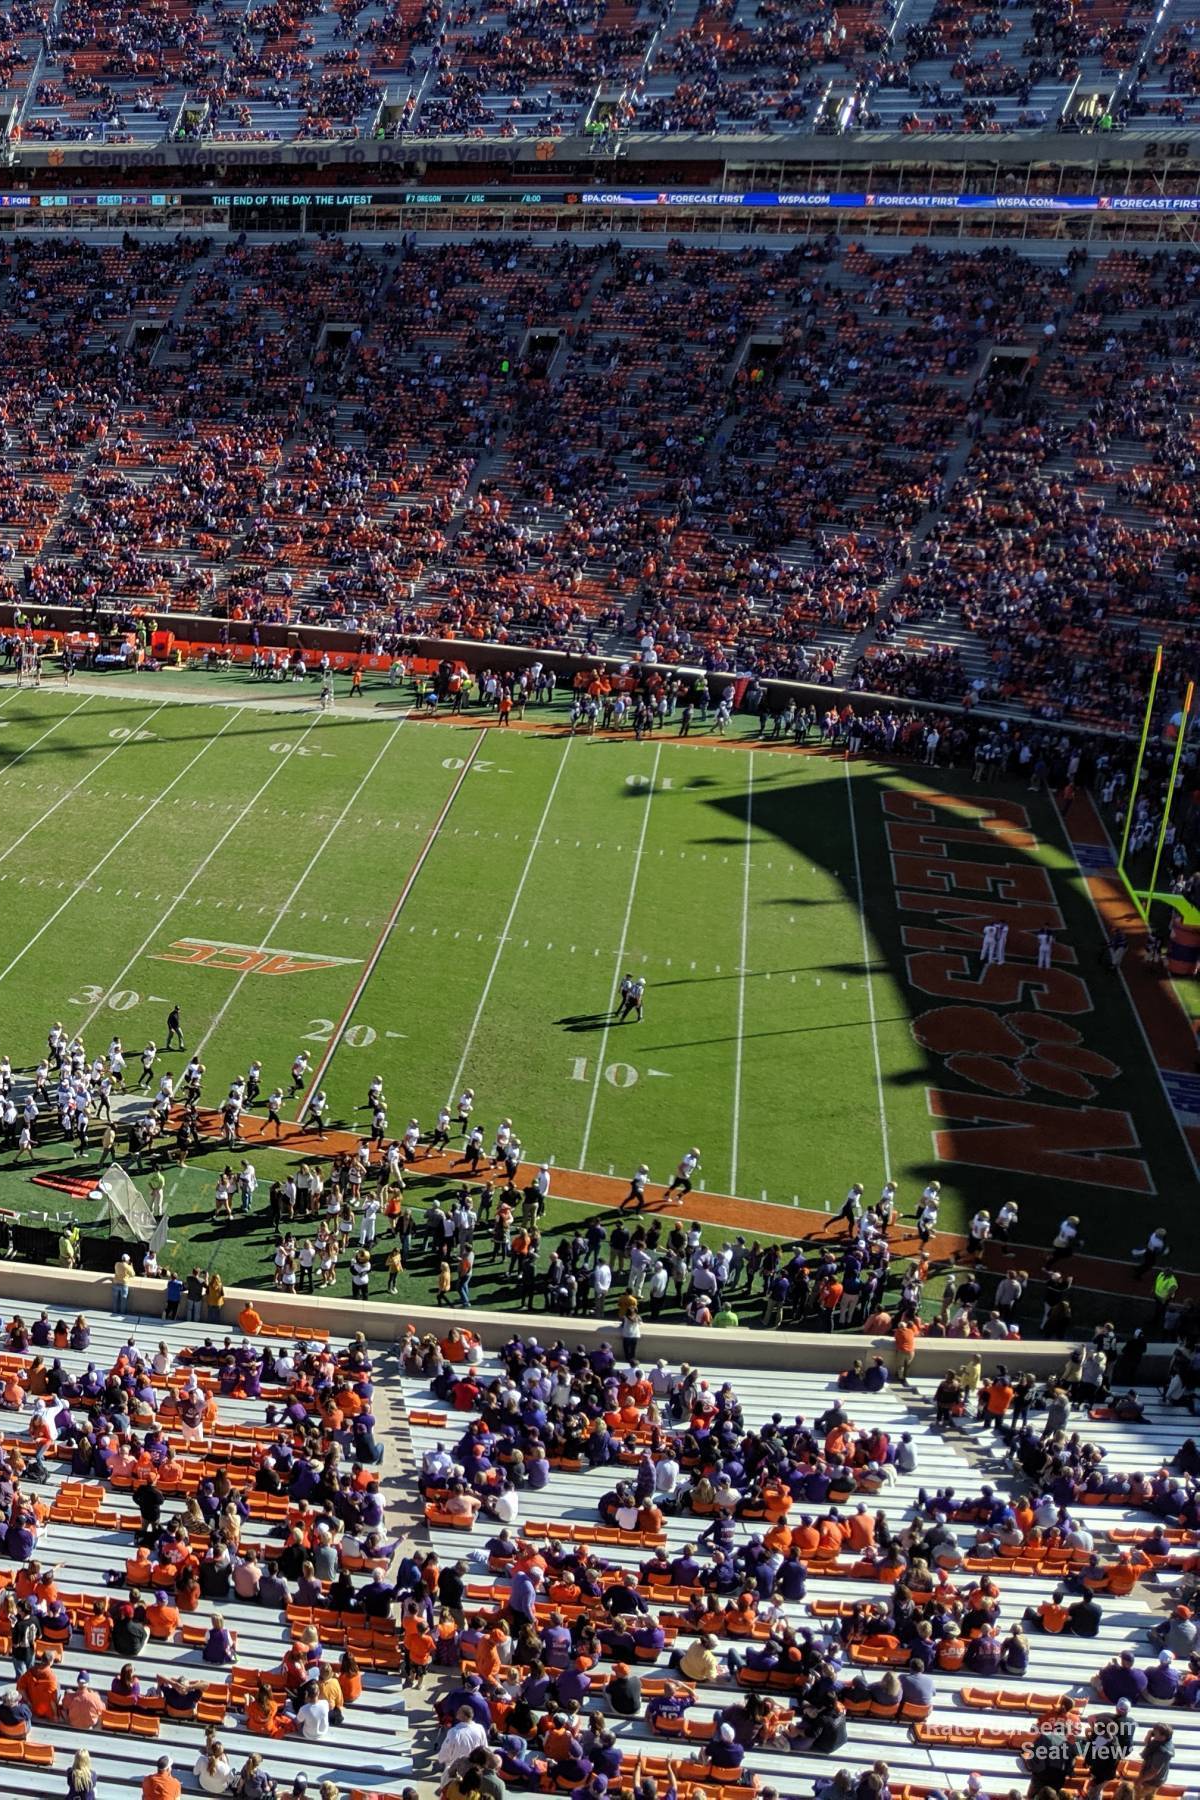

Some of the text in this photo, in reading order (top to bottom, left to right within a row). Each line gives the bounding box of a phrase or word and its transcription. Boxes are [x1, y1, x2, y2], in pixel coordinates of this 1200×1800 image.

[79, 144, 521, 166] Clemson Welcomes You To Death Valley
[212, 196, 231, 206] THE
[233, 196, 254, 206] END
[255, 196, 269, 205] OF
[270, 195, 290, 205] THE
[315, 195, 334, 205] THE
[336, 195, 373, 205] LATEST
[670, 194, 718, 204] FORECAST
[719, 194, 745, 204] FIRST
[777, 195, 831, 205] WSPA.COM
[878, 196, 931, 206] FORECAST
[931, 197, 960, 206] FIRST
[996, 197, 1054, 208] WSPA.COM
[1113, 198, 1171, 209] FORECAST
[108, 727, 158, 742] 40
[268, 742, 323, 757] 30
[441, 757, 497, 773] 20
[67, 984, 140, 1012] 30
[300, 1018, 377, 1048] 20
[564, 1056, 639, 1088] 10
[91, 1633, 105, 1648] 16
